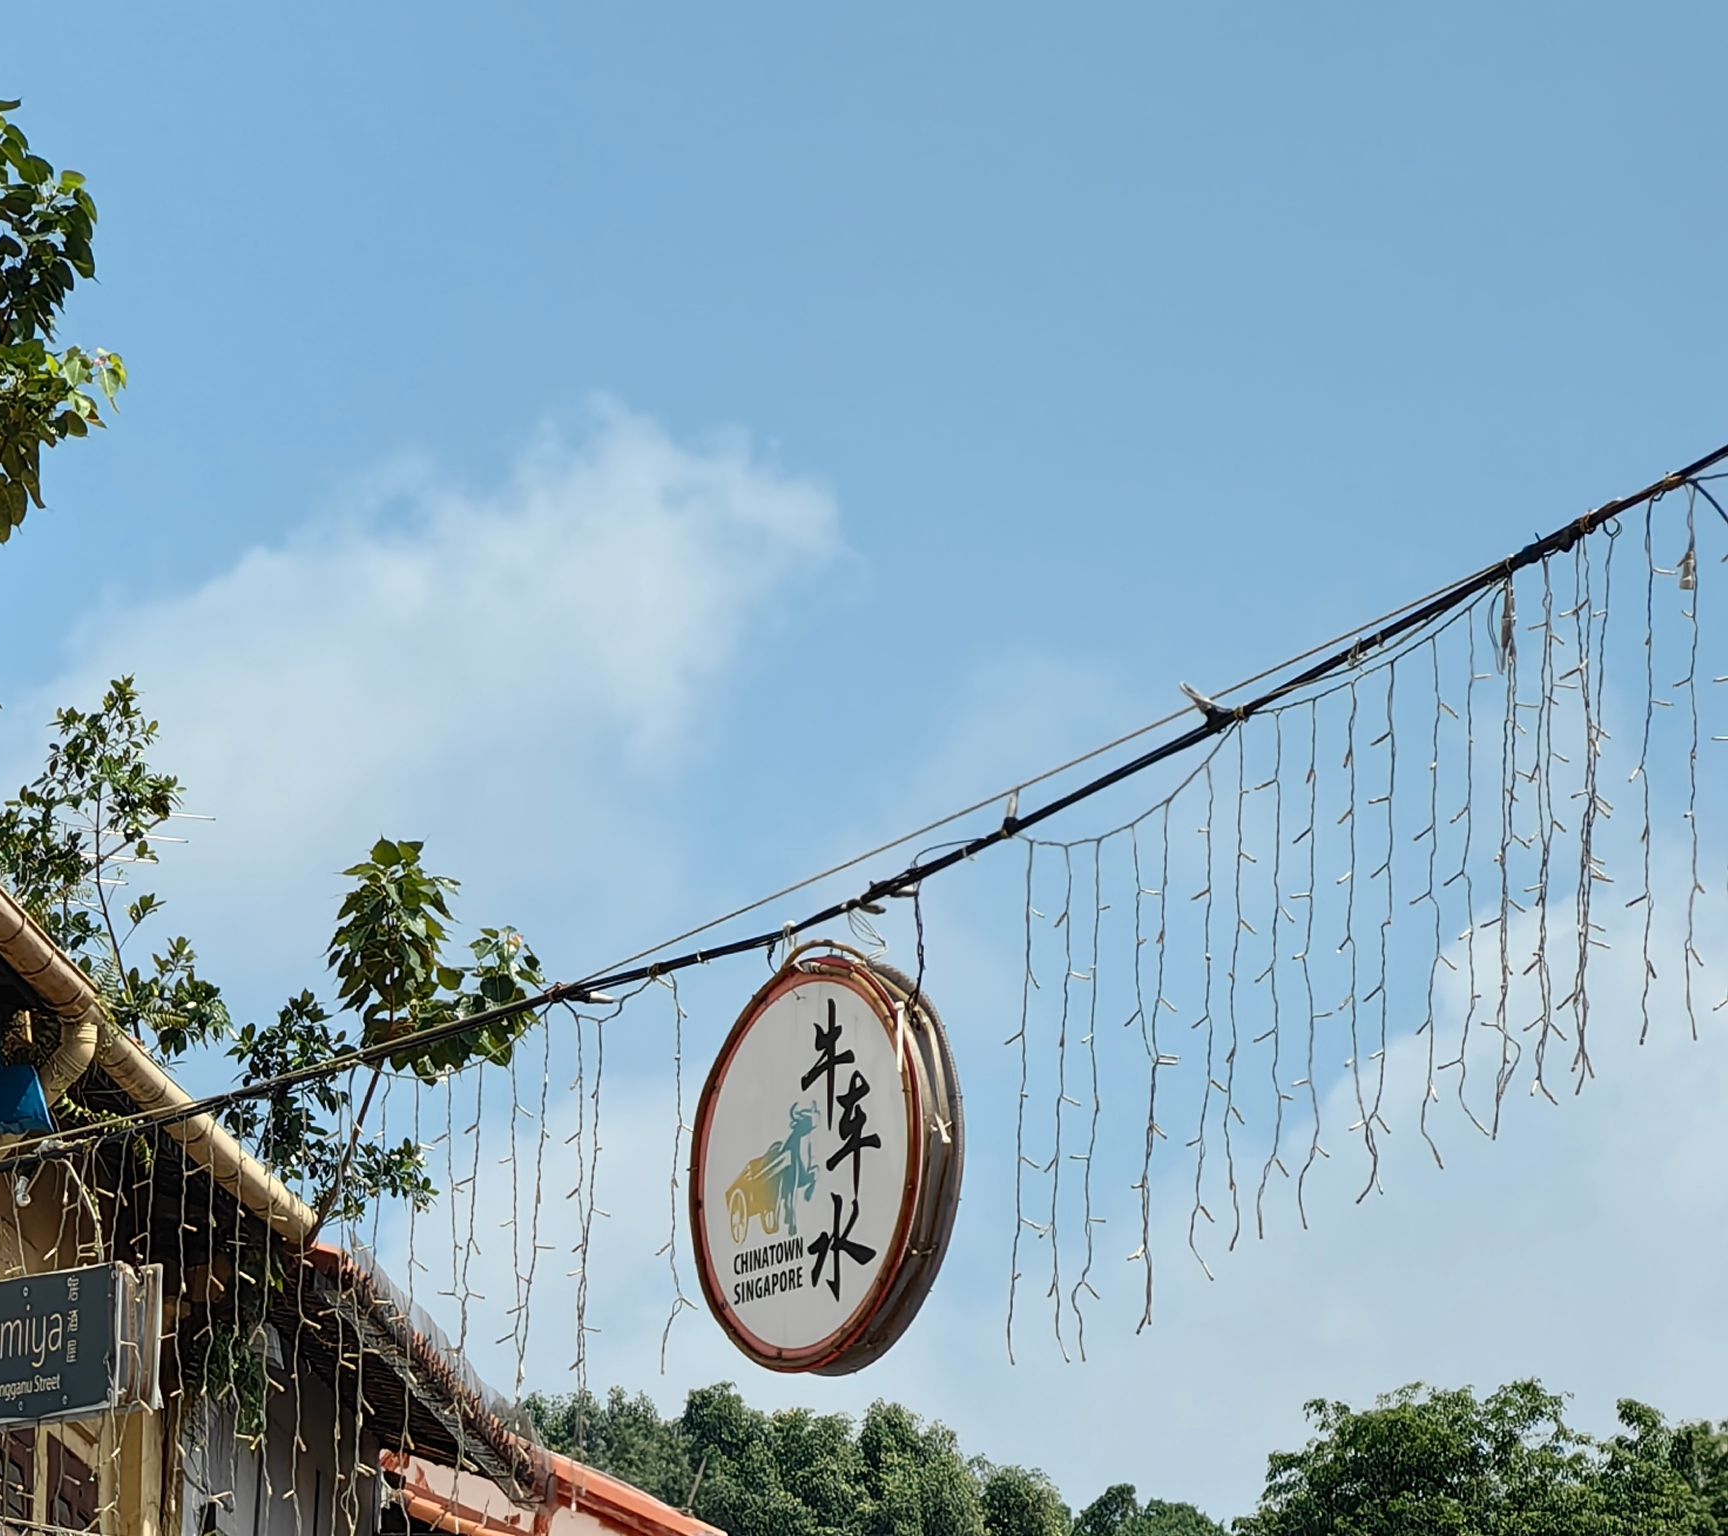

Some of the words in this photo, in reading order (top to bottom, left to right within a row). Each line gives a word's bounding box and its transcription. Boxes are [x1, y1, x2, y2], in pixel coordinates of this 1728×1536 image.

[801, 999, 880, 1302] 牛车水
[733, 1237, 804, 1276] CHINATOWN
[733, 1265, 803, 1305] SINGAPORE
[34, 1374, 61, 1393] Street
